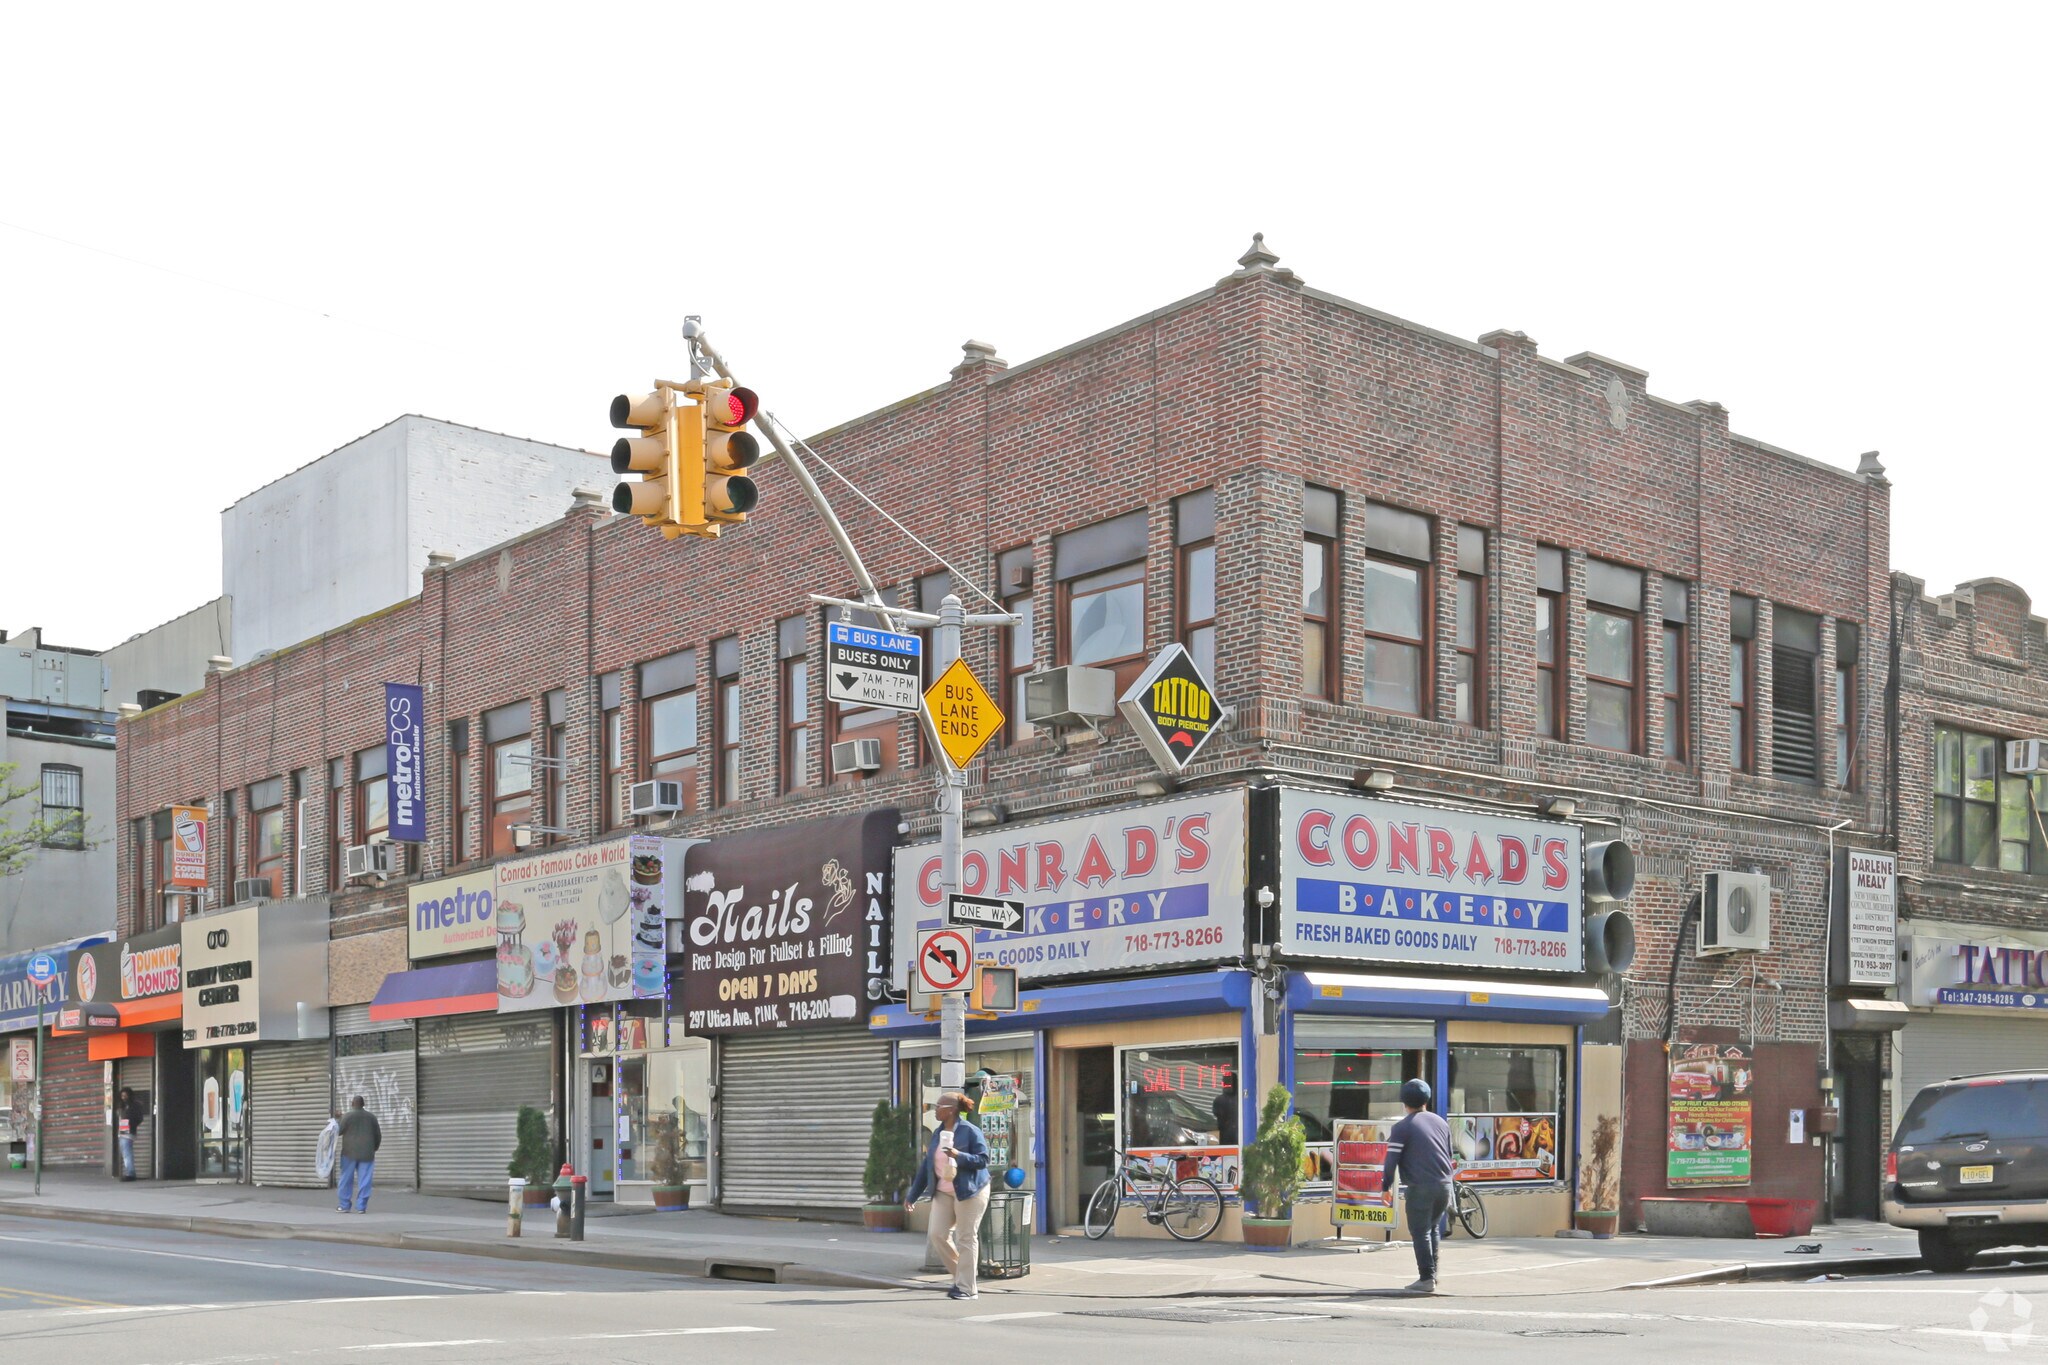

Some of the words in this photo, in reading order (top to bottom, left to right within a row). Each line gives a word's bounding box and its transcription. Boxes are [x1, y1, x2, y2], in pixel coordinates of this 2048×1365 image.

[853, 631, 877, 646] BUS
[881, 635, 913, 652] LANE
[838, 648, 877, 665] BUSES
[880, 655, 911, 671] ONLY
[861, 671, 883, 685] 7AM
[892, 676, 914, 690] 7PM
[862, 687, 885, 701] MON
[895, 691, 912, 704] FRI
[945, 684, 974, 702] BUS
[1152, 677, 1211, 721] TATTOO
[940, 702, 979, 720] LANE
[941, 720, 979, 738] ENDS
[1157, 715, 1177, 728] BODY
[1178, 719, 1210, 733] PIERCING
[412, 725, 420, 753] Dealer
[389, 697, 413, 826] metroPCS
[916, 811, 1212, 909] CONRAD'S
[1296, 808, 1570, 891] CONRAD'S
[500, 862, 538, 883] Conrad's
[540, 855, 573, 878] Famous
[575, 848, 598, 872] Cake
[600, 844, 626, 867] World
[1851, 857, 1893, 875] DARLENE
[1857, 874, 1888, 890] MEALY
[1850, 900, 1872, 910] COUNCIL
[1872, 902, 1894, 912] MEMBER
[1879, 893, 1891, 903] CITY
[689, 881, 814, 947] Nails
[959, 904, 982, 918] ONE
[991, 908, 1014, 922] WAY
[1865, 913, 1890, 922] DISTRICT
[443, 929, 485, 946] Authorized
[1295, 922, 1341, 943] FRESH
[1344, 926, 1390, 946] BAKED
[1394, 929, 1439, 950] GOODS
[1442, 933, 1478, 952] DAILY
[1852, 923, 1875, 931] DISTRICT
[1875, 925, 1893, 933] OFFICE
[1124, 926, 1224, 953] 718-773-8266
[1494, 937, 1568, 958] 718-773-8266
[1877, 938, 1895, 946] STREET
[136, 944, 180, 973] DUNKIN'
[692, 953, 712, 971] Free
[715, 948, 746, 971] Design
[750, 946, 766, 965] For
[770, 940, 803, 963] Fullset
[807, 939, 815, 958] &
[819, 933, 853, 957] Filling
[998, 945, 1044, 966] GOODS
[1047, 939, 1091, 961] DAILY
[137, 967, 180, 994] DONUTS
[718, 976, 759, 1002] OPEN
[763, 974, 772, 998] 7
[778, 968, 818, 996] DAYS
[1942, 990, 2015, 1005] Tel:347-295-0285
[689, 1010, 706, 1029] 297
[707, 1007, 732, 1028] Utica
[732, 1008, 753, 1025] Ave.
[755, 1004, 779, 1026] PINK
[594, 1066, 604, 1078] A
[1142, 1065, 1188, 1092] SALT
[1339, 1208, 1388, 1222] 718-773-8266
